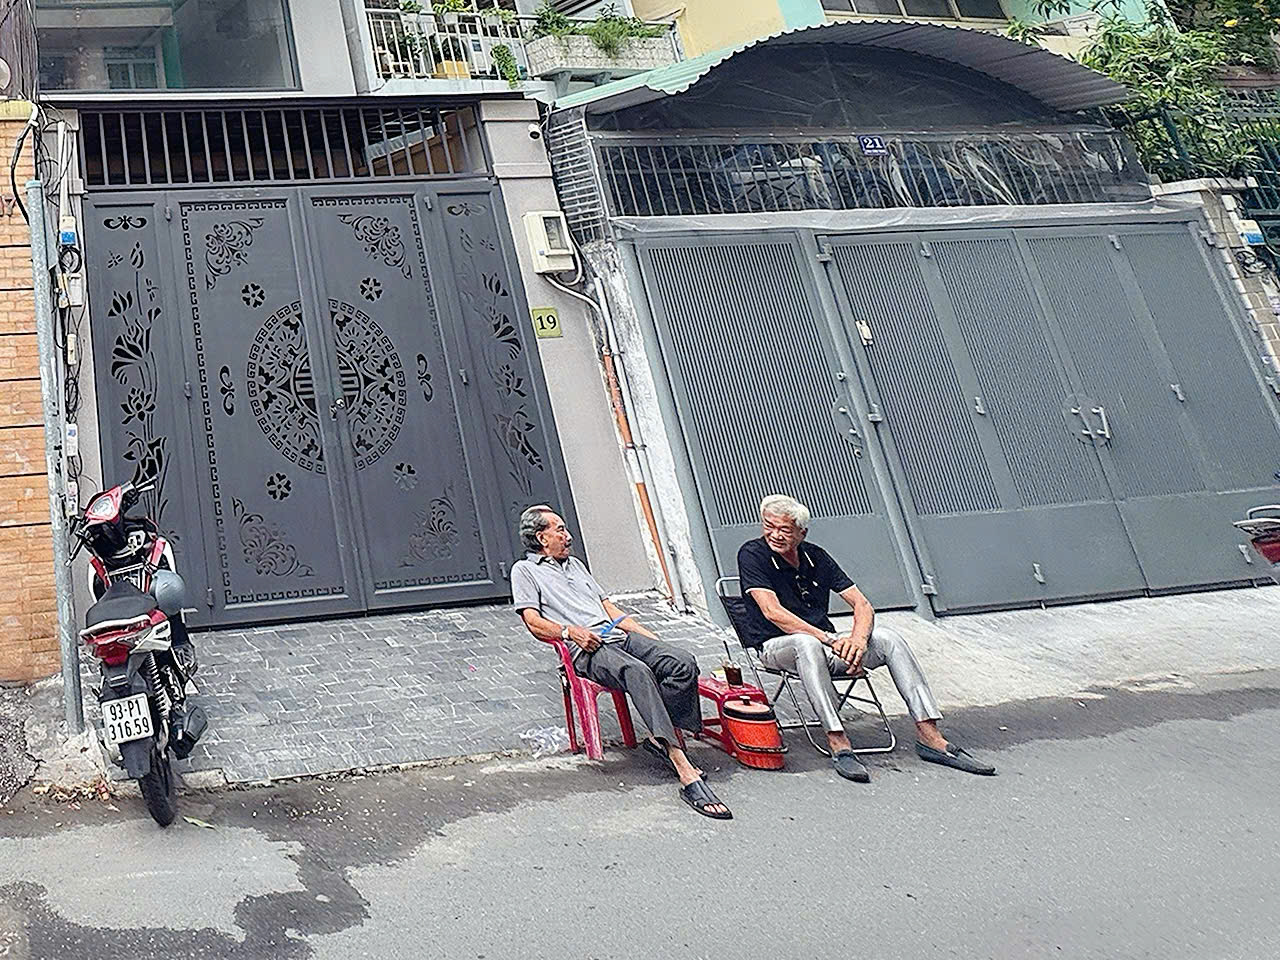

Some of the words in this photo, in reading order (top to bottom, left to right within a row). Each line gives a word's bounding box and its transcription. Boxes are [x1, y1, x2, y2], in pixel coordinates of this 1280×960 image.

[863, 137, 883, 149] 21
[536, 314, 557, 330] 19
[109, 716, 150, 741] 316.59
